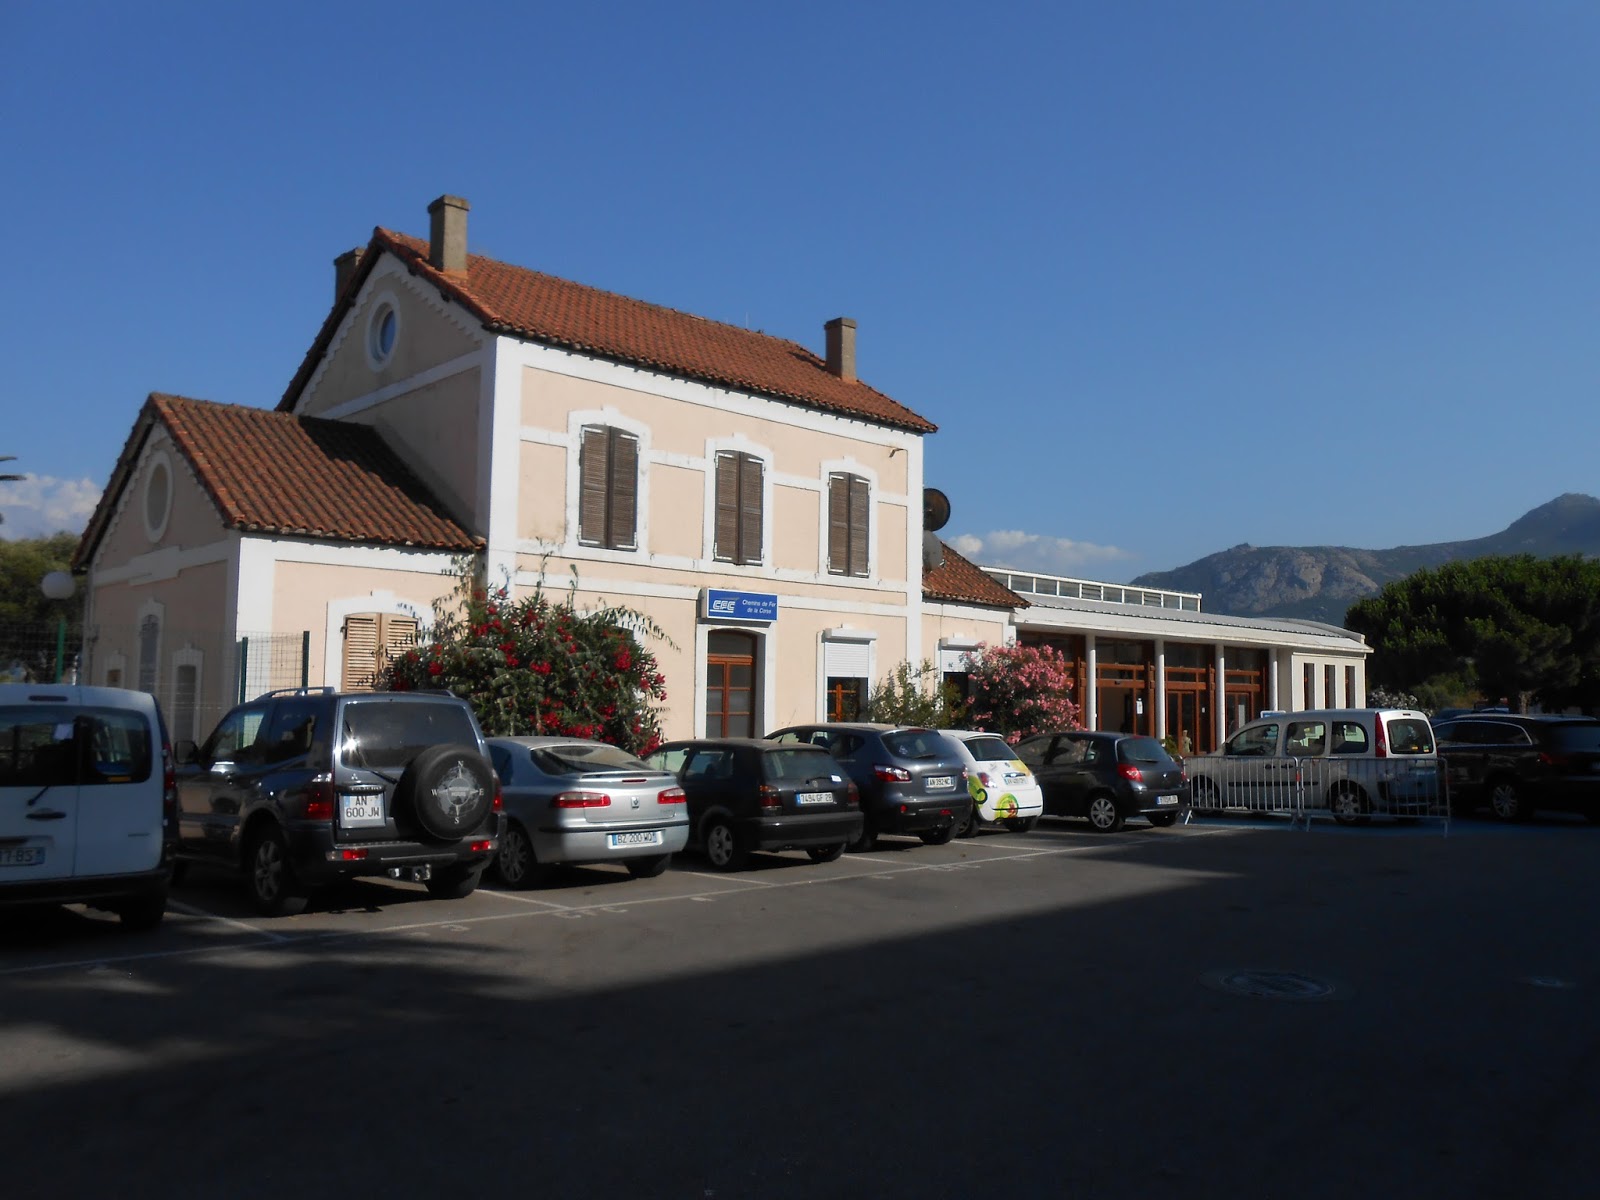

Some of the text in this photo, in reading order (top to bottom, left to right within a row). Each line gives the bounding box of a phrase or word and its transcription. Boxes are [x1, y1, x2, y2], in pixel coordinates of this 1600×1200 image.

[713, 600, 736, 611] CFC
[457, 760, 465, 768] N
[431, 788, 438, 796] W
[478, 787, 484, 796] E
[355, 795, 367, 805] AN
[454, 816, 460, 825] S
